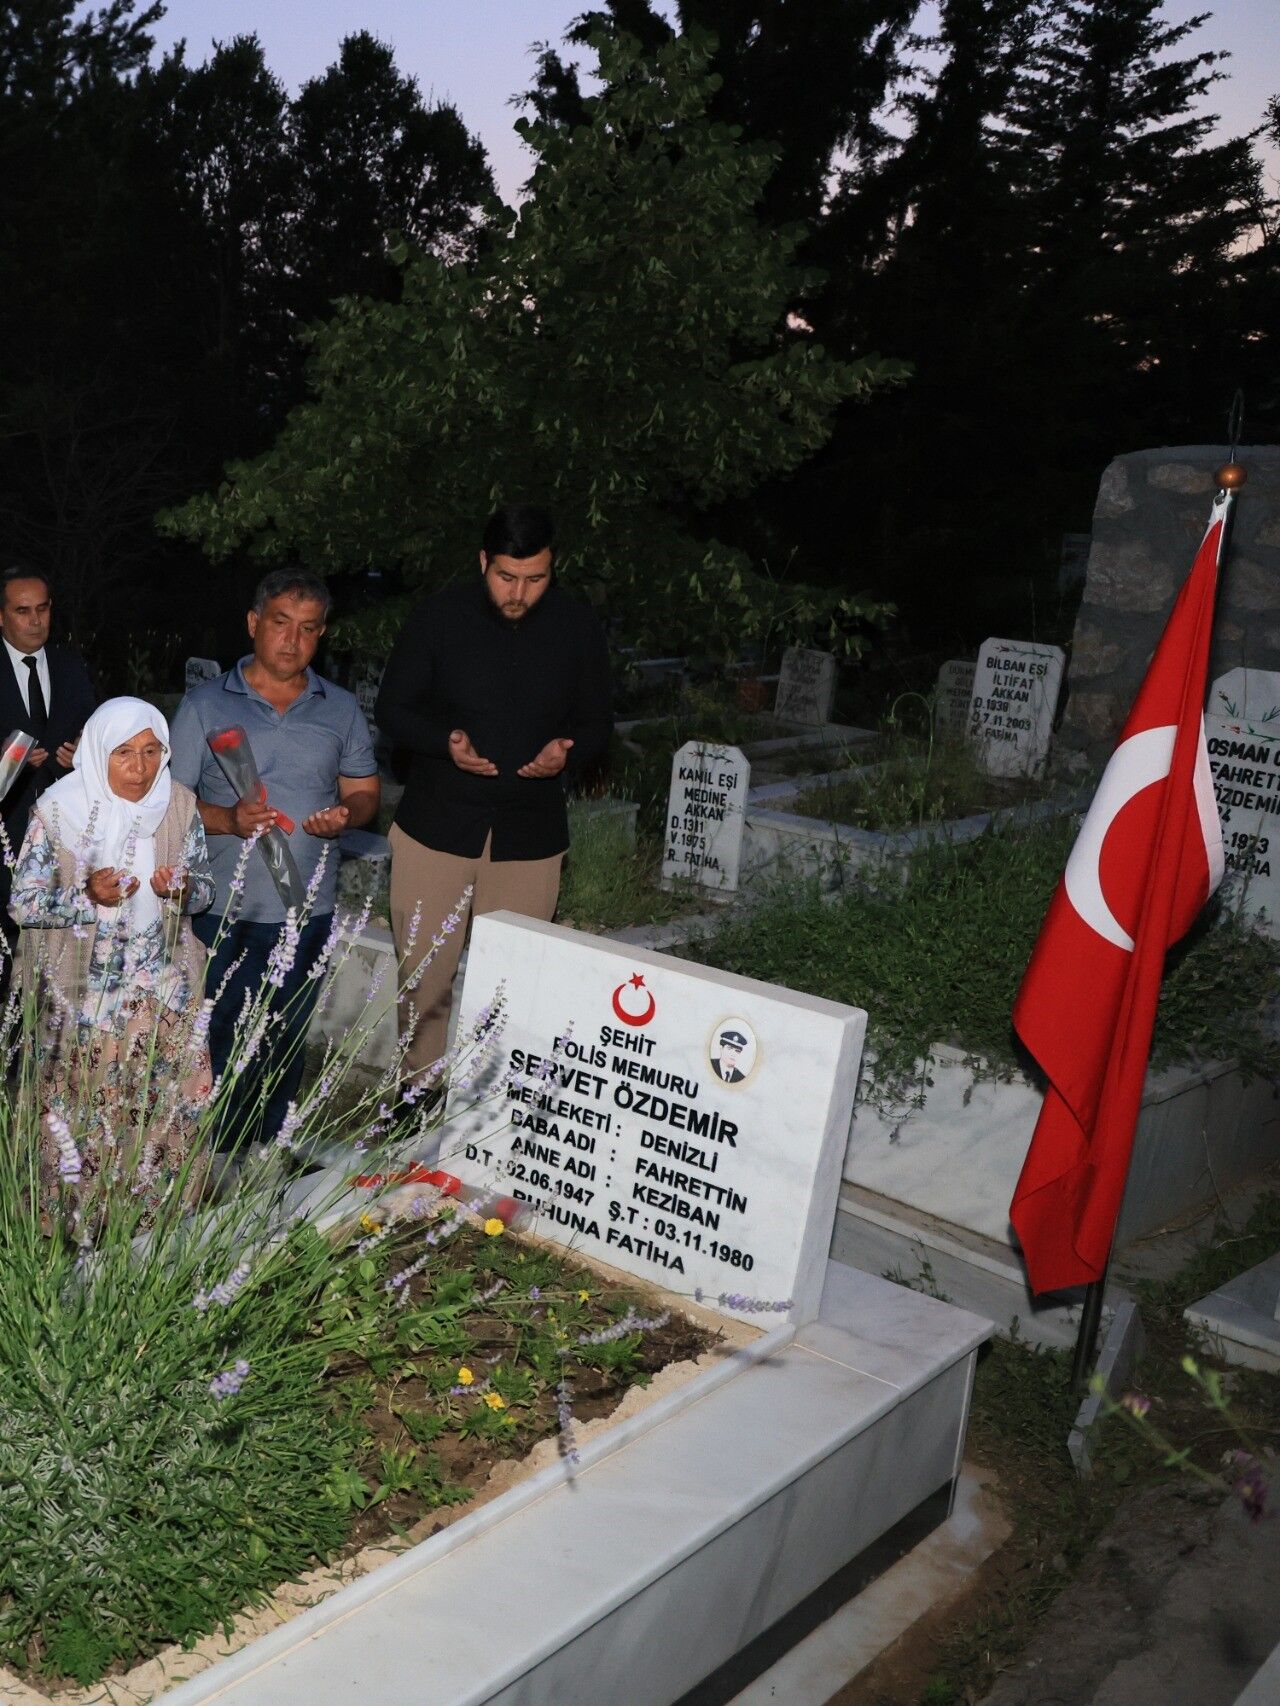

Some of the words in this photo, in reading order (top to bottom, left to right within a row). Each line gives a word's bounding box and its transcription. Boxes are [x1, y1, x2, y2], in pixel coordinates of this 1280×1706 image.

[986, 656, 1026, 672] BİLBAN
[991, 687, 1029, 703] AKKAN
[993, 674, 1034, 690] İLTİFAT
[1207, 737, 1270, 764] OSMAN
[684, 787, 727, 806] MEDİNE
[718, 773, 738, 792] EŞİ
[685, 803, 724, 821] AKKAN
[600, 1025, 657, 1057] ŞEHİT
[611, 1056, 699, 1099] MEMURU
[509, 1049, 608, 1100] SERVET
[614, 1081, 738, 1148] ÖZDEMİR
[510, 1108, 560, 1141] BABA
[563, 1129, 596, 1154] ADI
[635, 1157, 748, 1214] FAHRETTİN
[640, 1129, 718, 1173] DENİZLİ
[510, 1136, 562, 1168] ANNE
[563, 1157, 597, 1181] ADI
[632, 1182, 720, 1231] KEZİBAN
[506, 1160, 595, 1207] 02.06.1947
[608, 1200, 639, 1225] Ş.T
[654, 1219, 754, 1272] 03.11.1980
[605, 1227, 685, 1275] FATİHA
